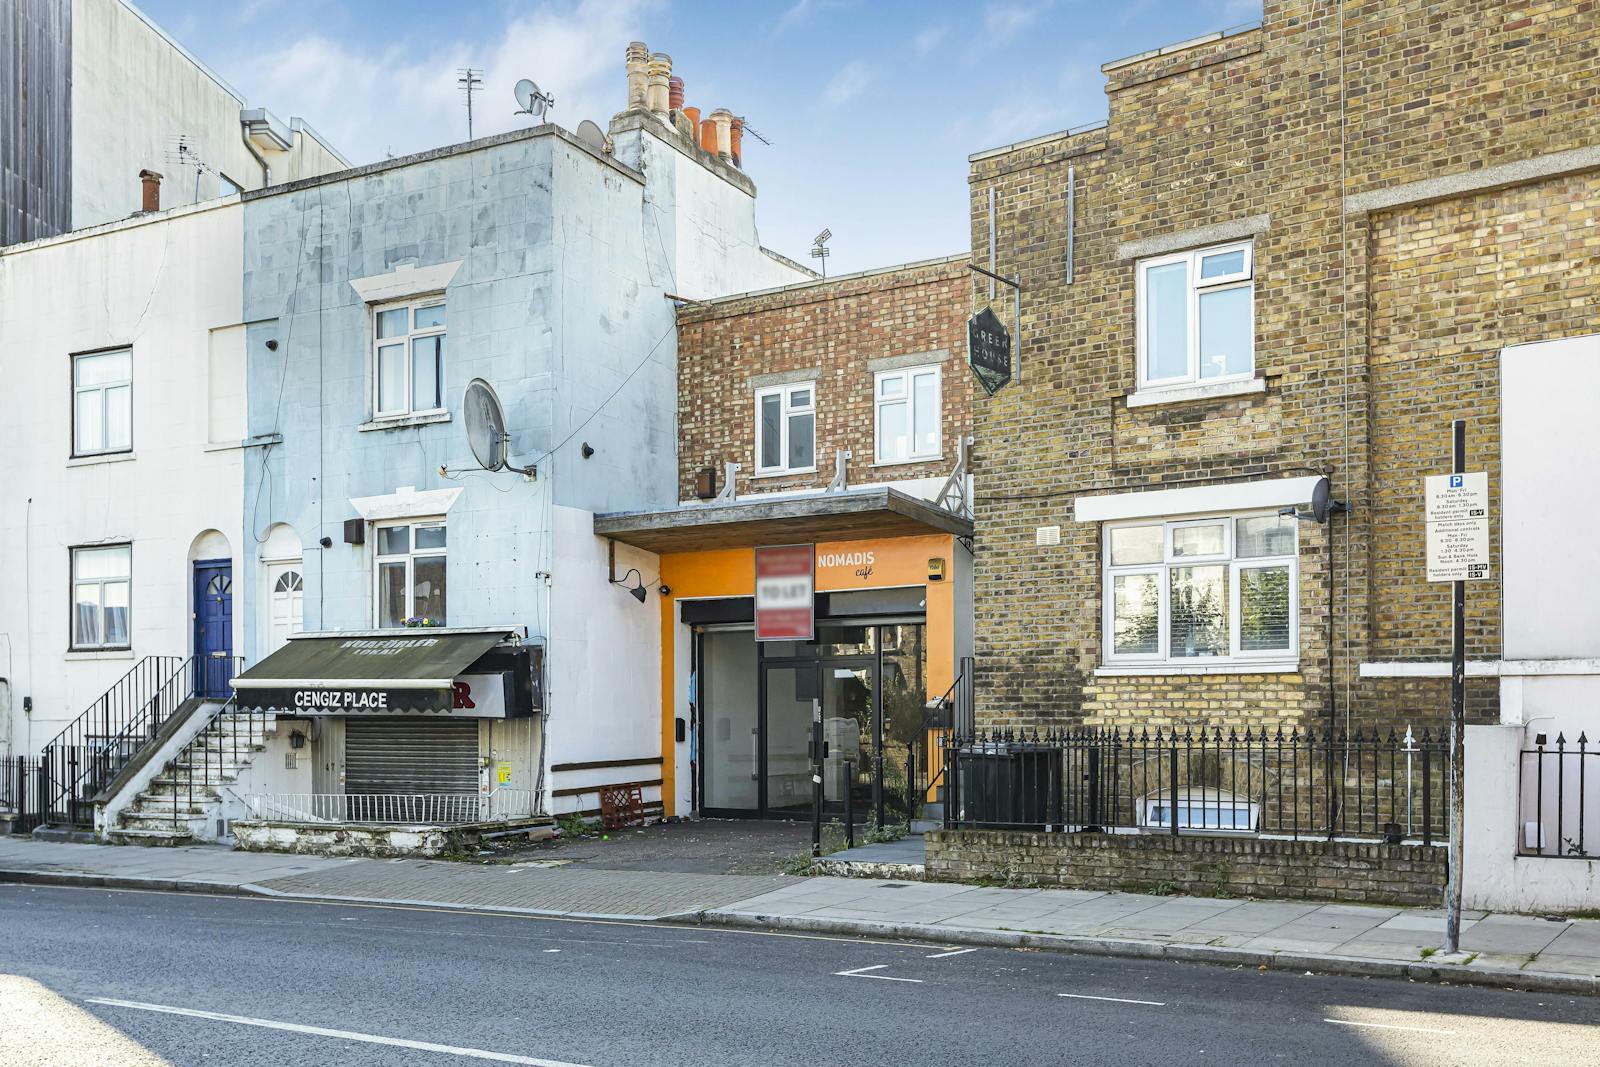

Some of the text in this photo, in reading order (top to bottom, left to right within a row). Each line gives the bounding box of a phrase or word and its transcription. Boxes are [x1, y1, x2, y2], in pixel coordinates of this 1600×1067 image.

[1452, 476, 1462, 487] P
[818, 551, 875, 568] NOMADIS
[855, 567, 874, 580] café
[294, 690, 388, 708] CENGIZ PLACE
